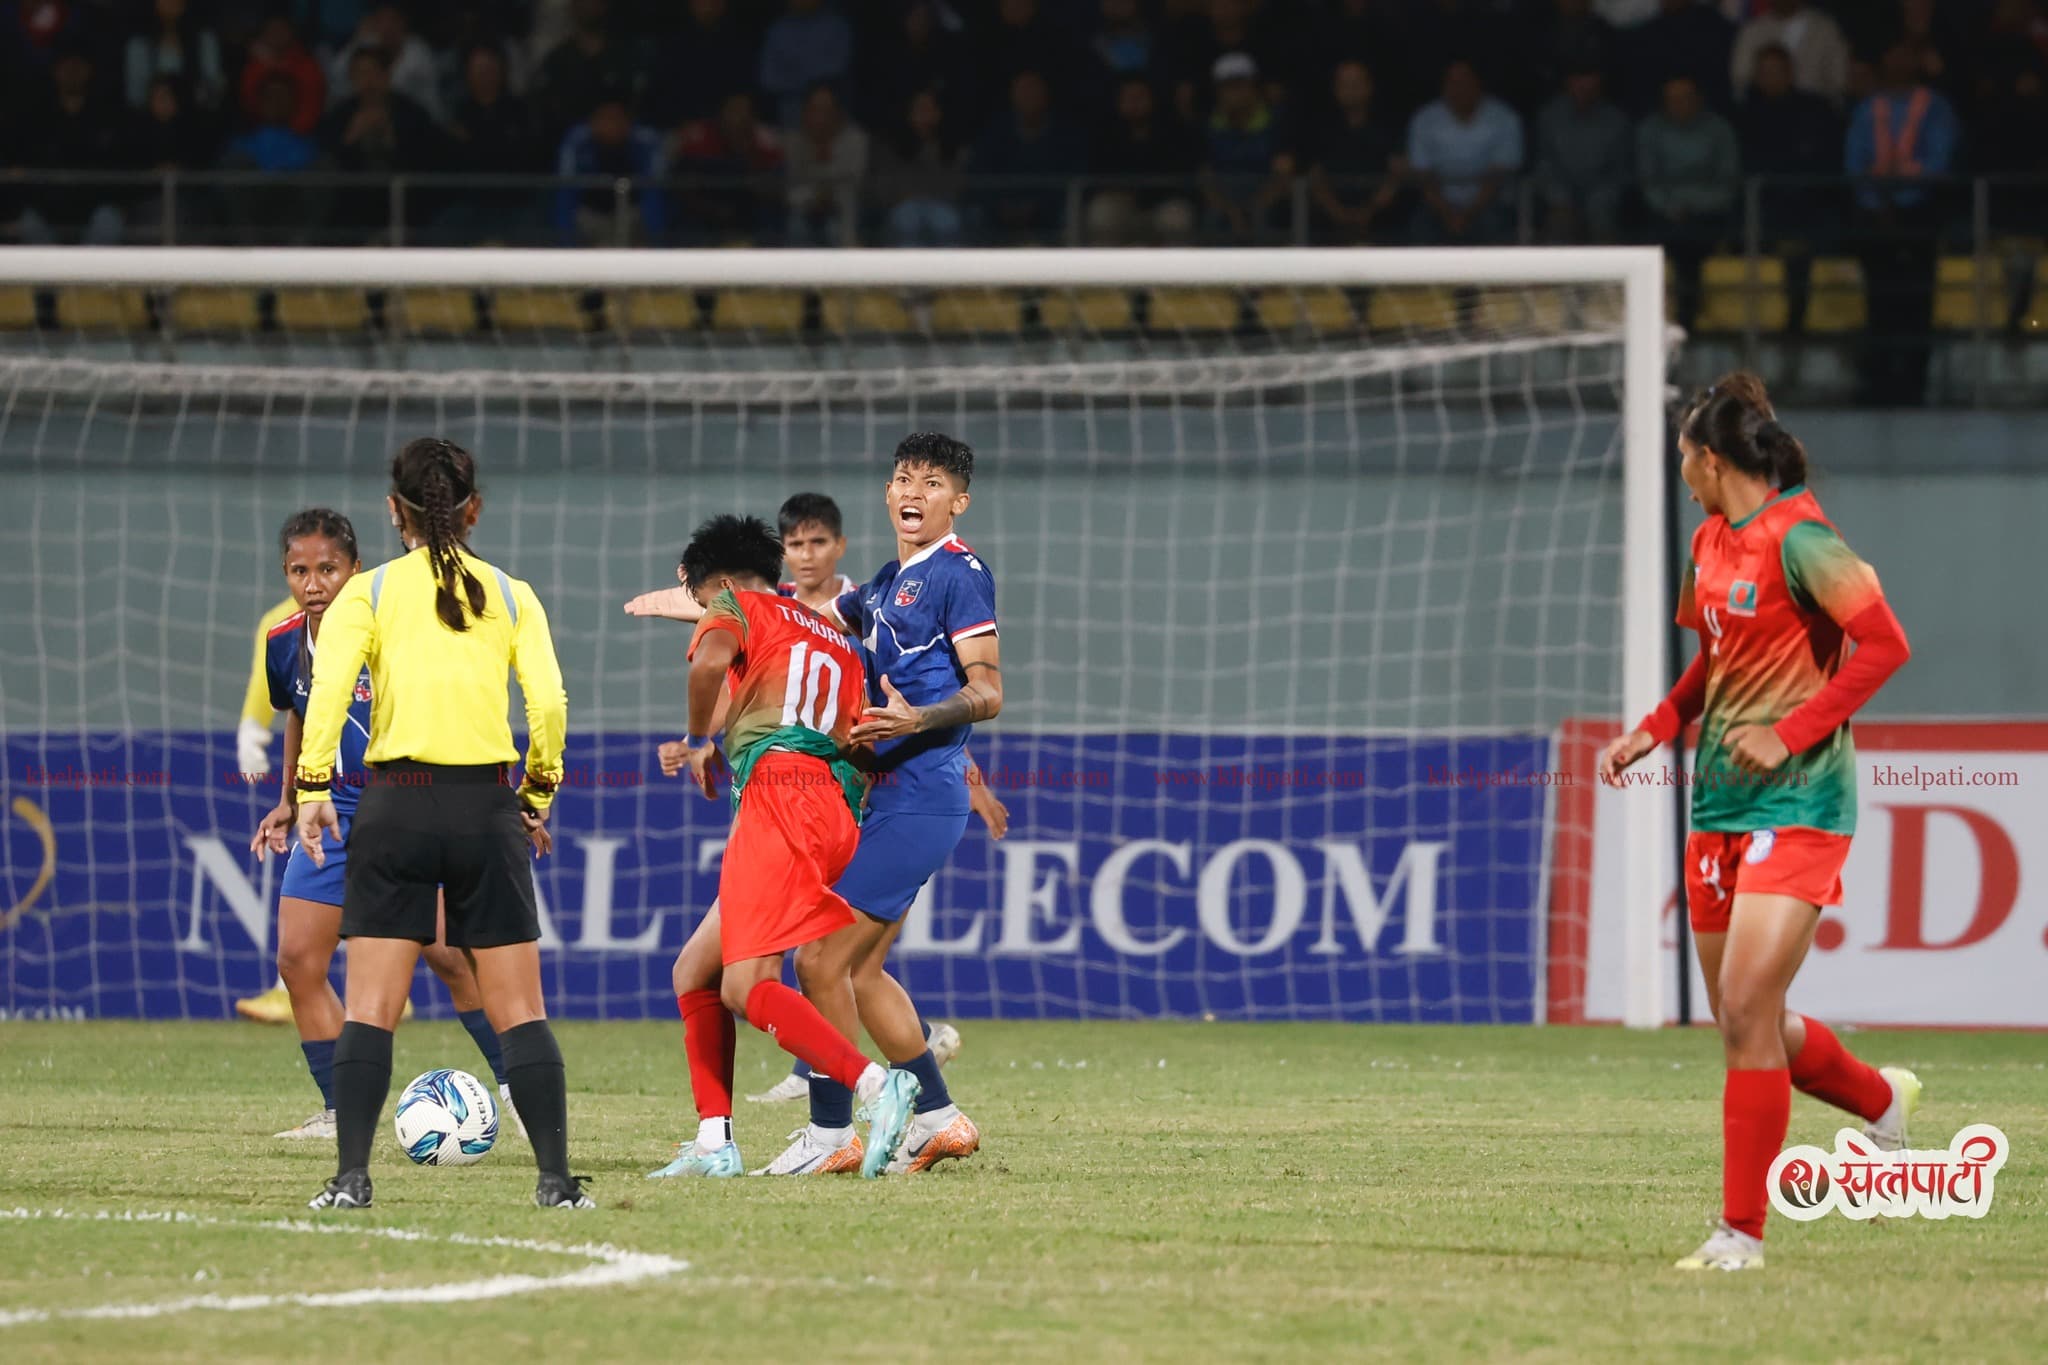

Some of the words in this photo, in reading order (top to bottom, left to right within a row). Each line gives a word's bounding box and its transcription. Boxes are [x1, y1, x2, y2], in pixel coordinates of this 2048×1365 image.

[779, 641, 842, 735] 10
[699, 837, 1448, 957] LECOM
[464, 1080, 488, 1125] KELME
